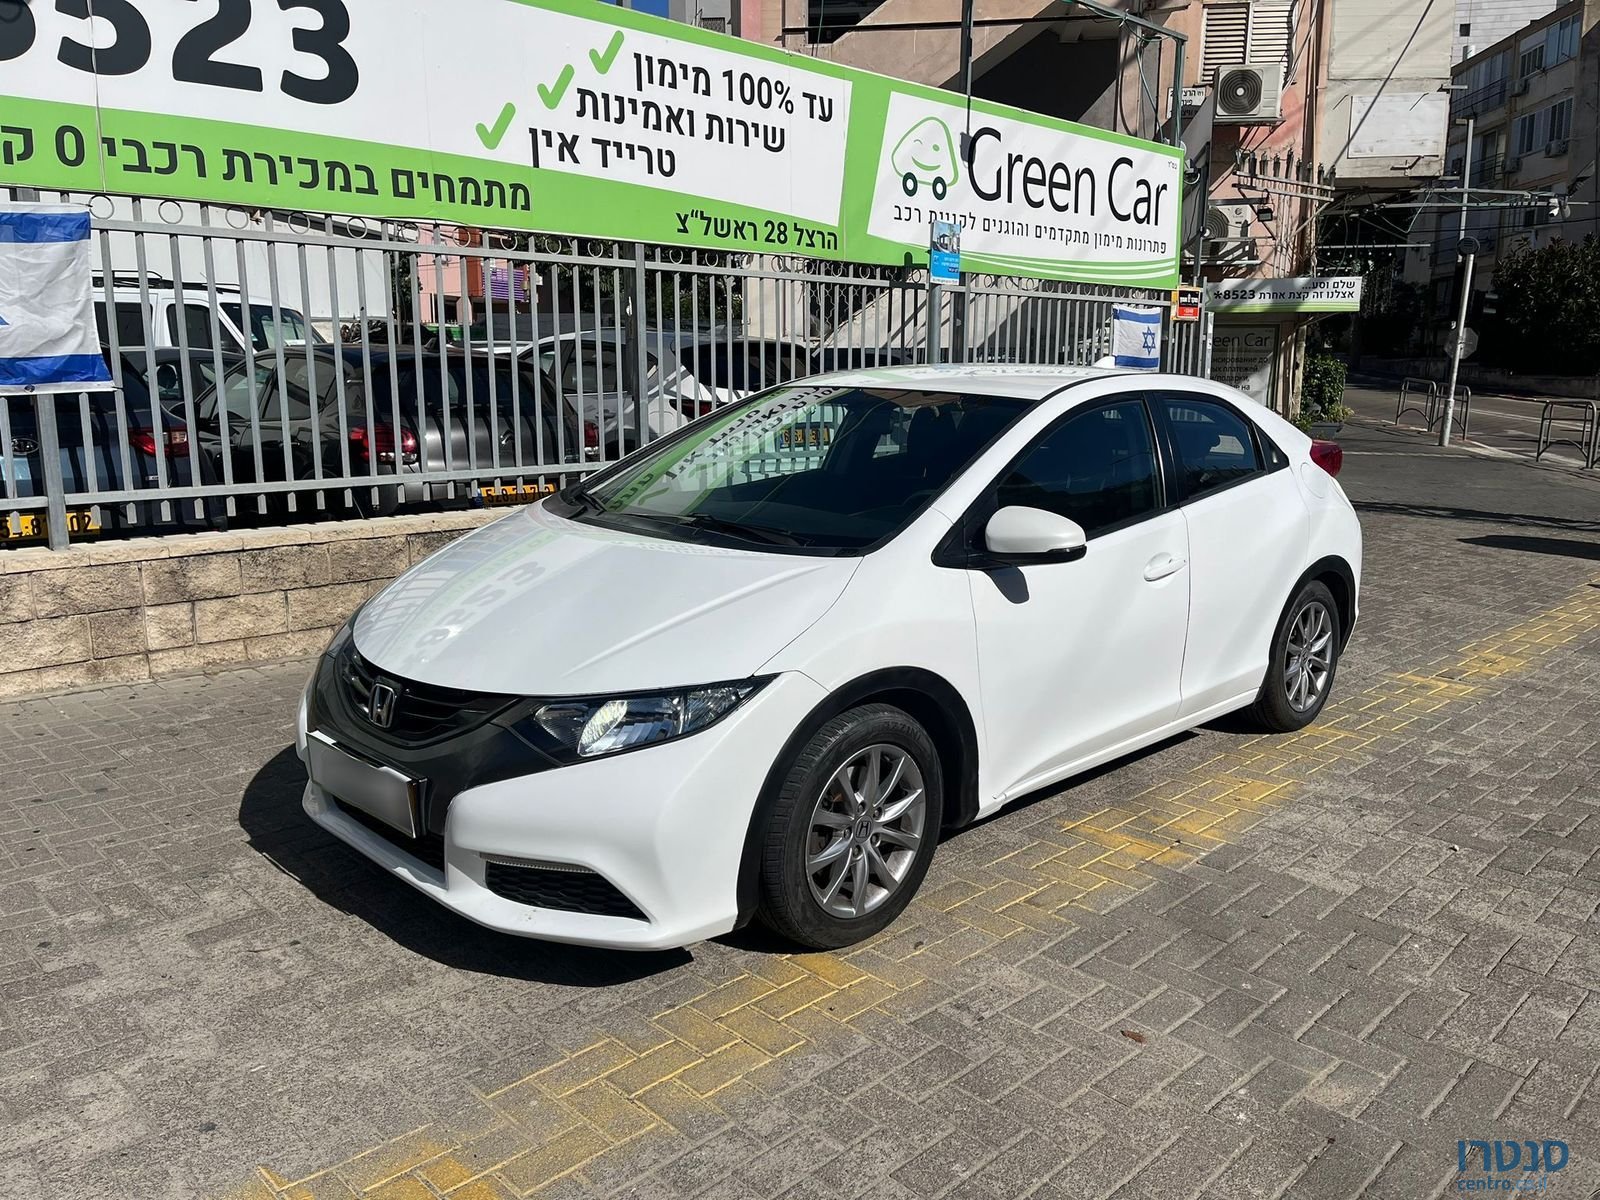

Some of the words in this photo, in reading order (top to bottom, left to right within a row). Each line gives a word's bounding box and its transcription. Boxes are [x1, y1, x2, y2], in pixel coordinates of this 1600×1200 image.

[0, 0, 359, 104] 523
[633, 52, 711, 97] מימון
[723, 69, 795, 115] 100%
[802, 92, 833, 123] עד
[576, 87, 694, 137] ואמינות
[55, 125, 86, 167] 0
[529, 127, 580, 169] אין
[704, 113, 786, 153] שירות
[101, 136, 207, 178] רכבי
[222, 148, 379, 196] במכירת
[591, 138, 676, 177] טרייד
[391, 167, 532, 212] מתמחים
[967, 126, 1096, 217] Green
[1108, 156, 1168, 226] Car
[675, 209, 758, 241] ראשל"צ
[893, 205, 921, 223] רכב
[982, 217, 1029, 237] והוגנים
[764, 219, 788, 245] 28
[793, 222, 838, 250] הרצל
[1035, 224, 1090, 246] מתקדמים
[1094, 232, 1123, 249] מימון
[1126, 237, 1167, 254] פתרונות
[1258, 291, 1286, 300] אחרת
[1288, 291, 1309, 301] קצת
[1312, 291, 1324, 299] זה
[1326, 290, 1354, 299] אצלנו
[1332, 280, 1356, 289] שלם
[1244, 332, 1270, 347] Car
